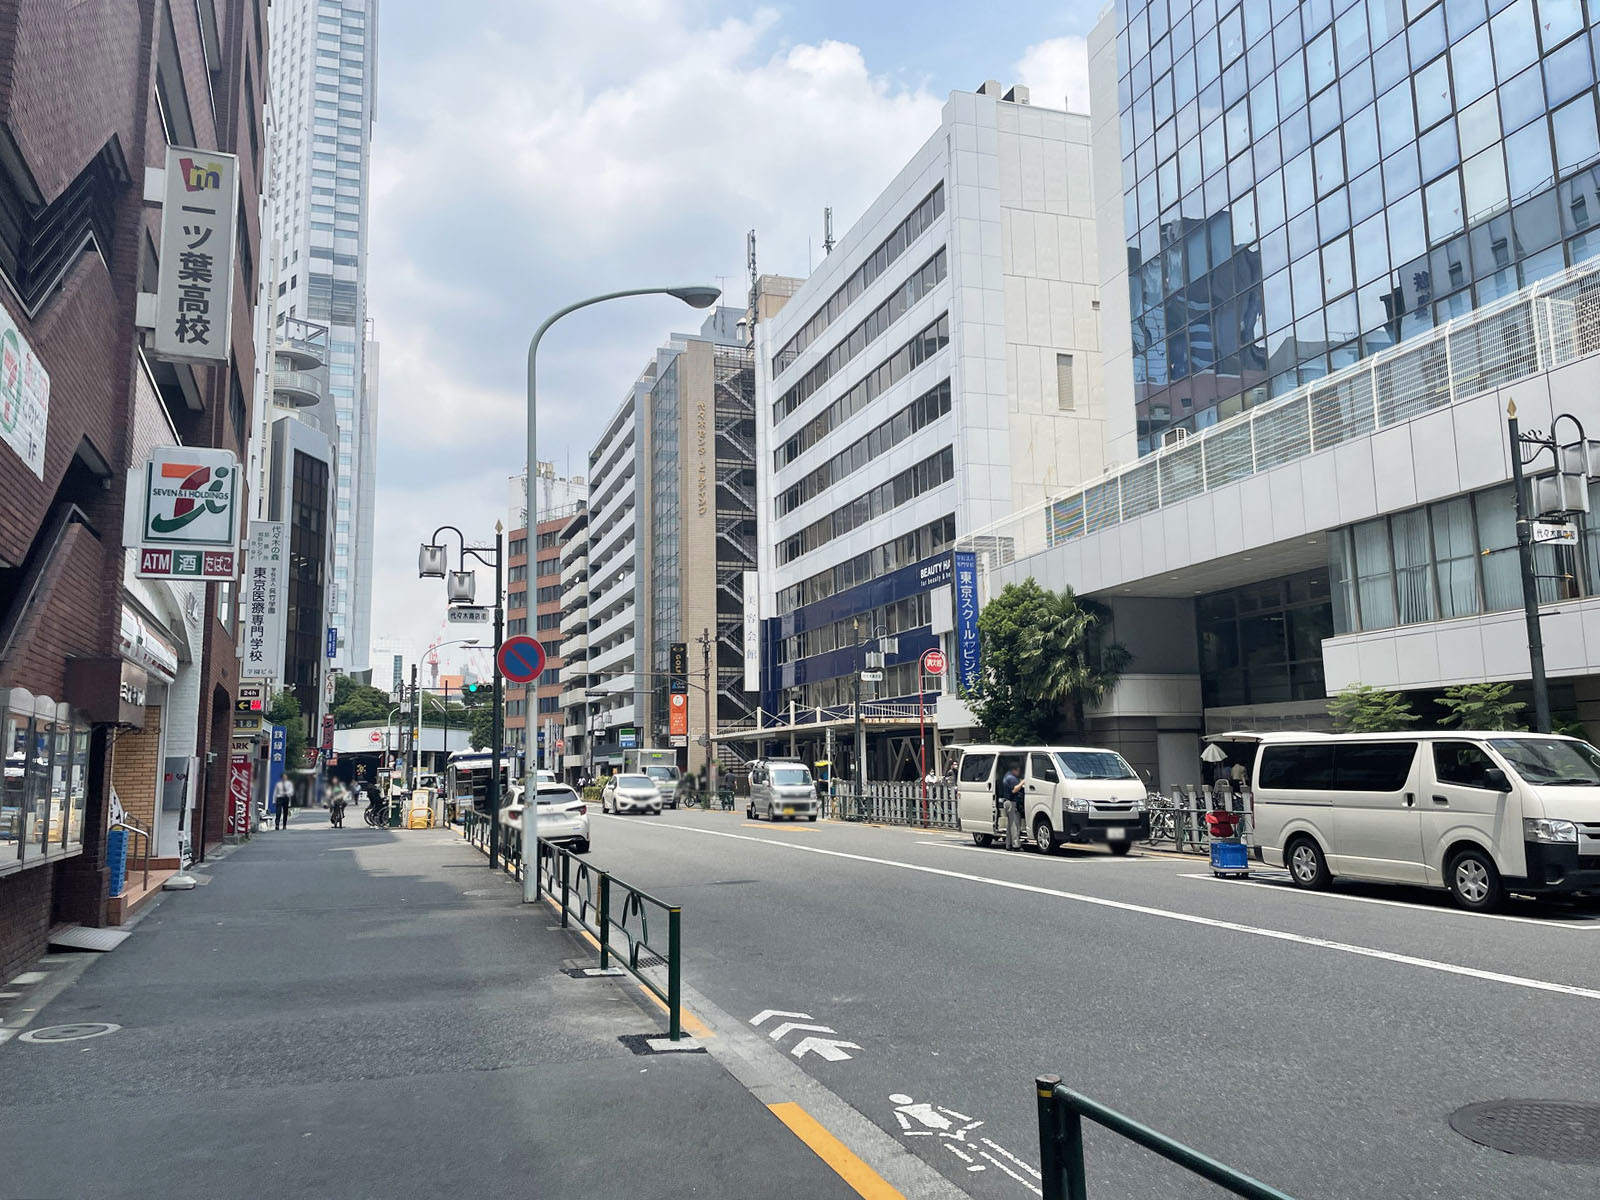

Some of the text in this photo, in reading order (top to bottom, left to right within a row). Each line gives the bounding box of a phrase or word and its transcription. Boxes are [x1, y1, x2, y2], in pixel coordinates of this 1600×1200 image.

[174, 205, 216, 346] 一ツ葉高校
[188, 490, 229, 500] HOLDINGS
[142, 552, 171, 571] ATM
[178, 554, 198, 572] 酒
[204, 555, 232, 573] たばこ
[920, 562, 943, 579] BEAUTY
[249, 566, 267, 662] 東京医療専門学校
[746, 594, 757, 660] 美容会館
